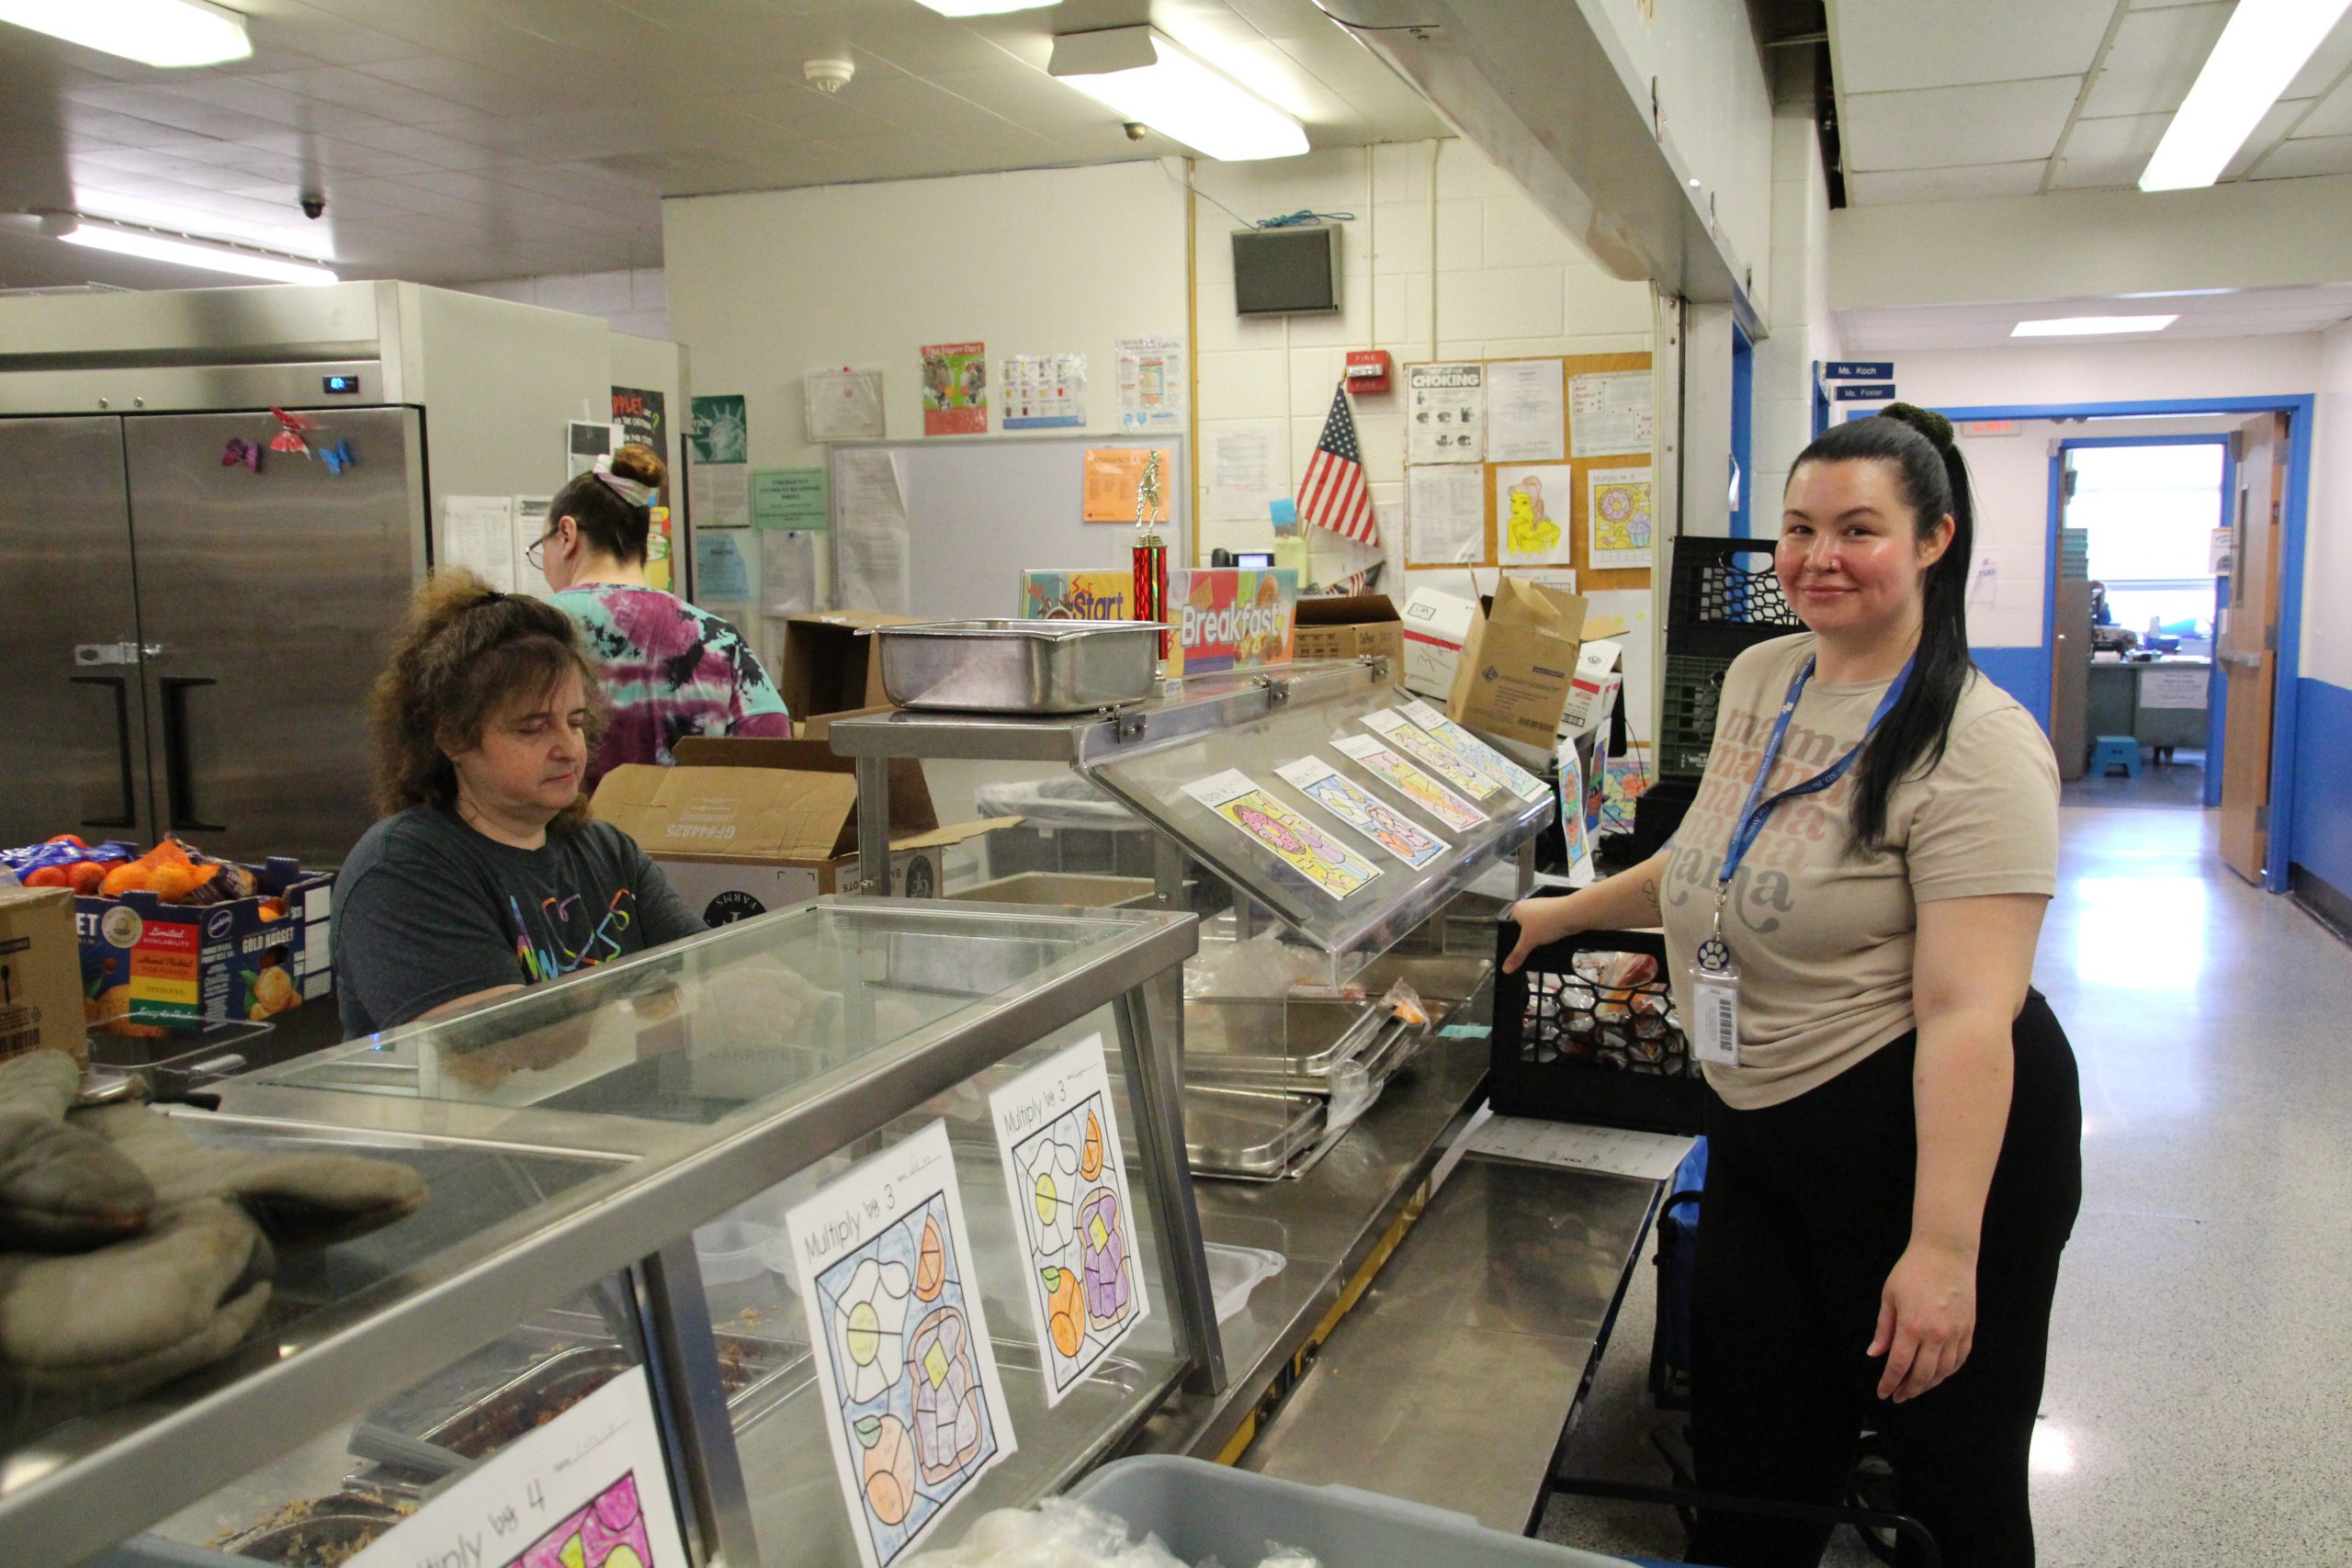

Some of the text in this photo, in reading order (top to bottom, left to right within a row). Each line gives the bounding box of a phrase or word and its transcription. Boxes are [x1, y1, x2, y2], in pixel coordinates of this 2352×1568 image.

[1412, 374, 1479, 388] CHOKING
[1838, 367, 1851, 375] Ms.
[1073, 592, 1124, 620] Start
[1182, 599, 1280, 648] Breakfast
[716, 893, 758, 909] FARMS
[142, 938, 191, 947] AVAILABILITY
[149, 927, 185, 938] Limited
[243, 926, 294, 954] GOLD NUGGET
[1003, 1079, 1067, 1138] Multiply by 3
[804, 1183, 896, 1264] Multiply by 3
[488, 1505, 520, 1535] by
[526, 1477, 545, 1512] 4
